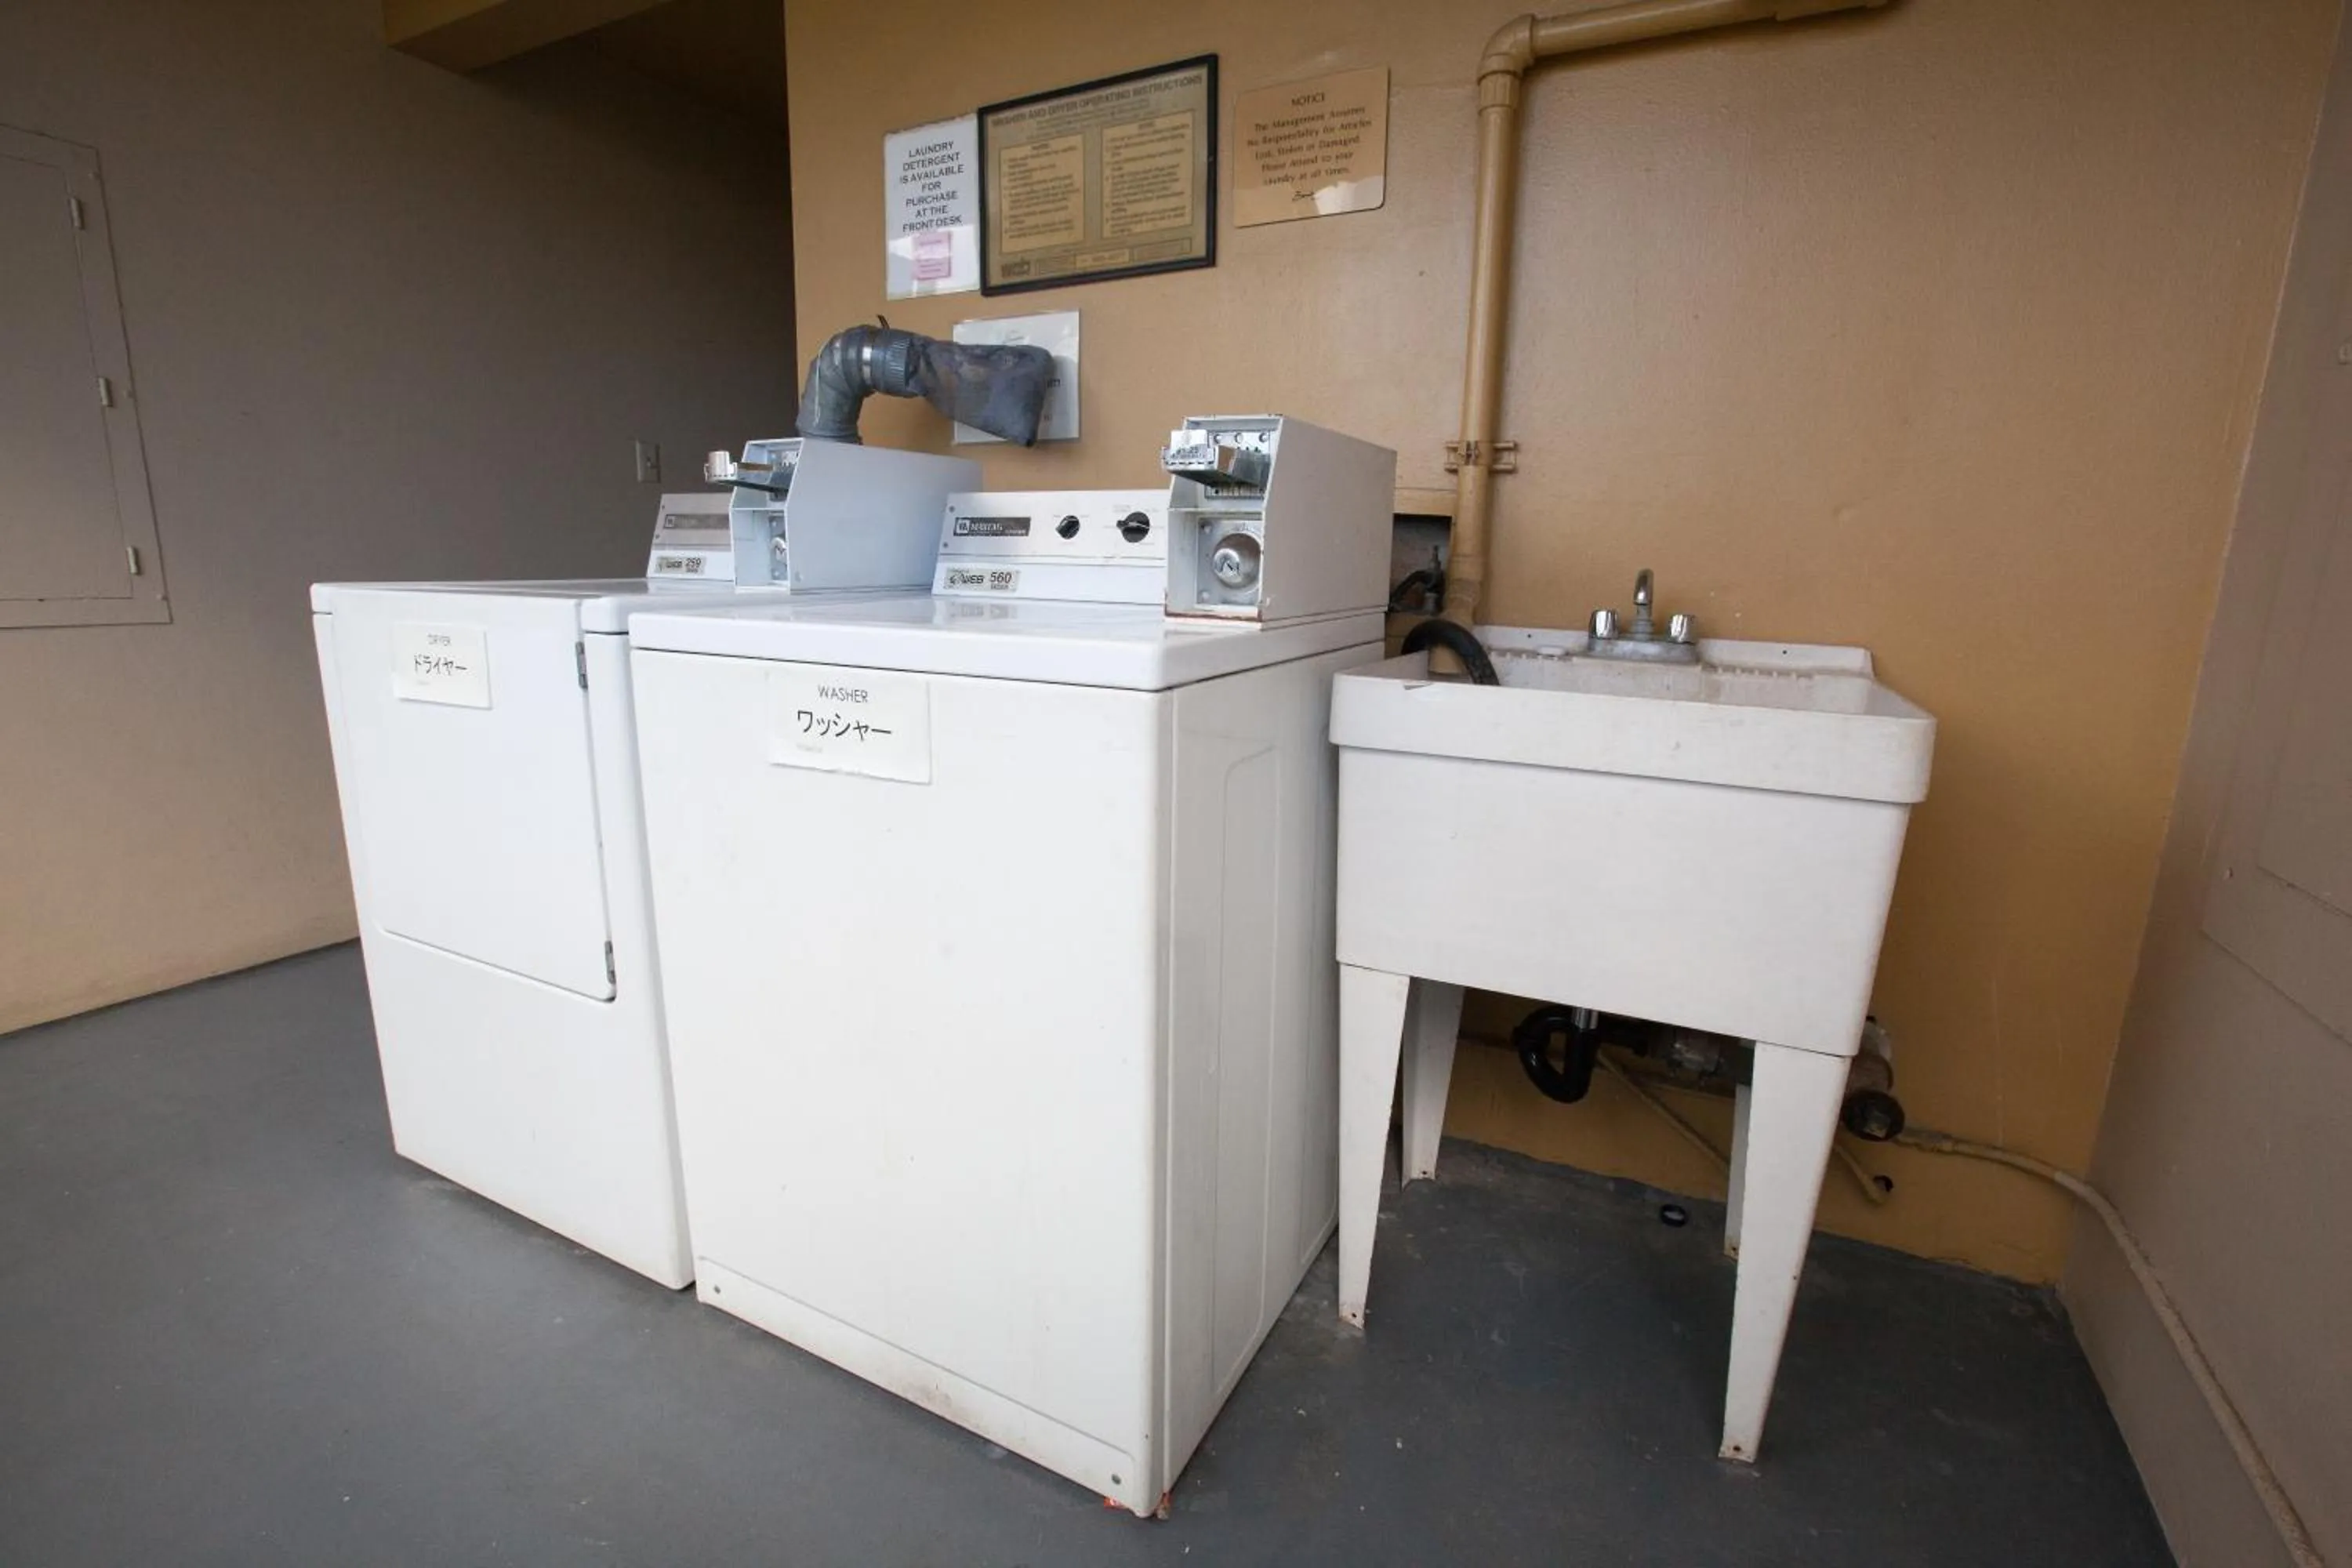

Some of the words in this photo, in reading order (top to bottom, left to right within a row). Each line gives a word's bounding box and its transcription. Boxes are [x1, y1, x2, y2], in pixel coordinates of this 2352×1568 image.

[1291, 93, 1325, 106] NOTICE
[1254, 122, 1269, 132] The
[1273, 114, 1325, 130] Management
[1261, 129, 1319, 145] Responsibility
[1319, 135, 1360, 149] Damaged
[909, 140, 953, 158] LAUNDRY
[902, 152, 960, 172] DETERGENT
[900, 176, 909, 185] IS
[909, 164, 965, 183] AVAILABLE
[921, 180, 942, 193] FOR
[906, 191, 958, 208] PURCHASE
[915, 208, 929, 218] AT
[930, 205, 948, 216] THE
[902, 219, 935, 233] FRONT
[935, 215, 963, 227] DESK
[989, 572, 1012, 584] 560
[818, 684, 869, 703] WASHER
[797, 710, 892, 742] ワッシャー
